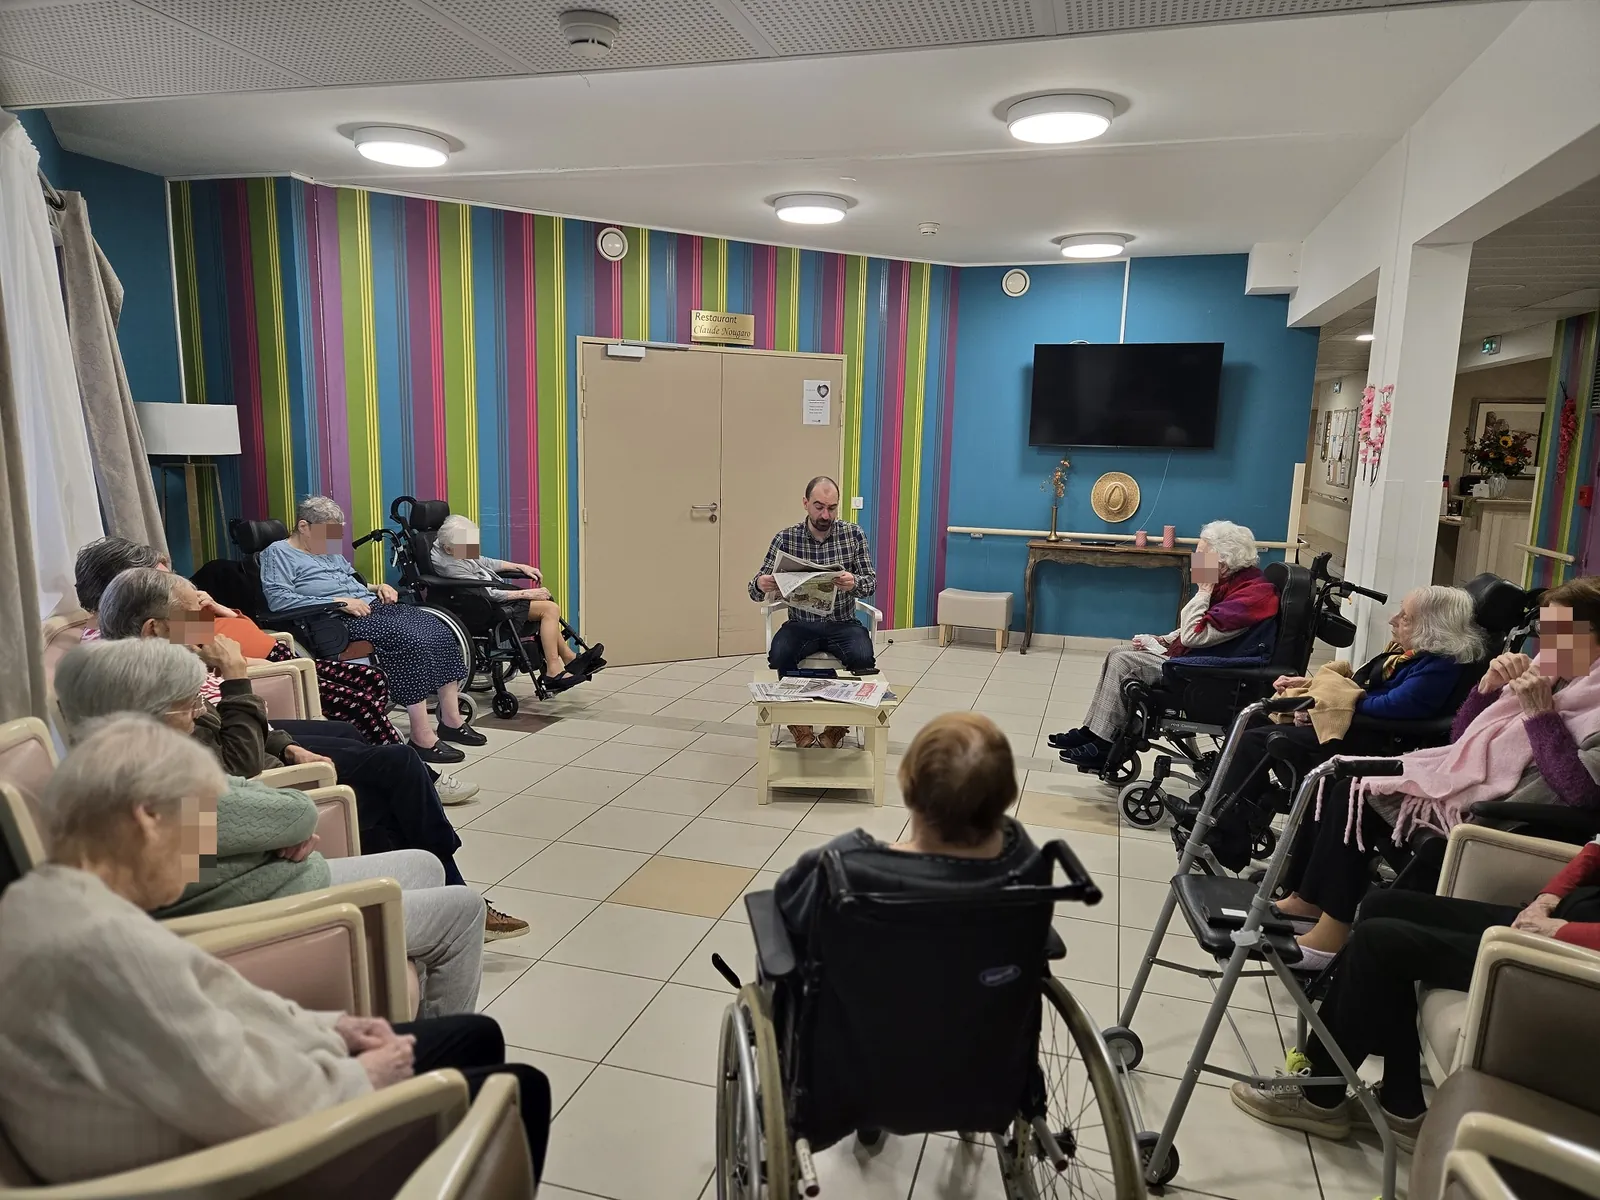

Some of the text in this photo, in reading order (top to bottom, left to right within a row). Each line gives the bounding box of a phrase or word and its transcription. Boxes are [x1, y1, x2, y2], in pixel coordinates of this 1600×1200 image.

[695, 312, 737, 324] Restaurant
[693, 324, 751, 339] Claude Nougaro
